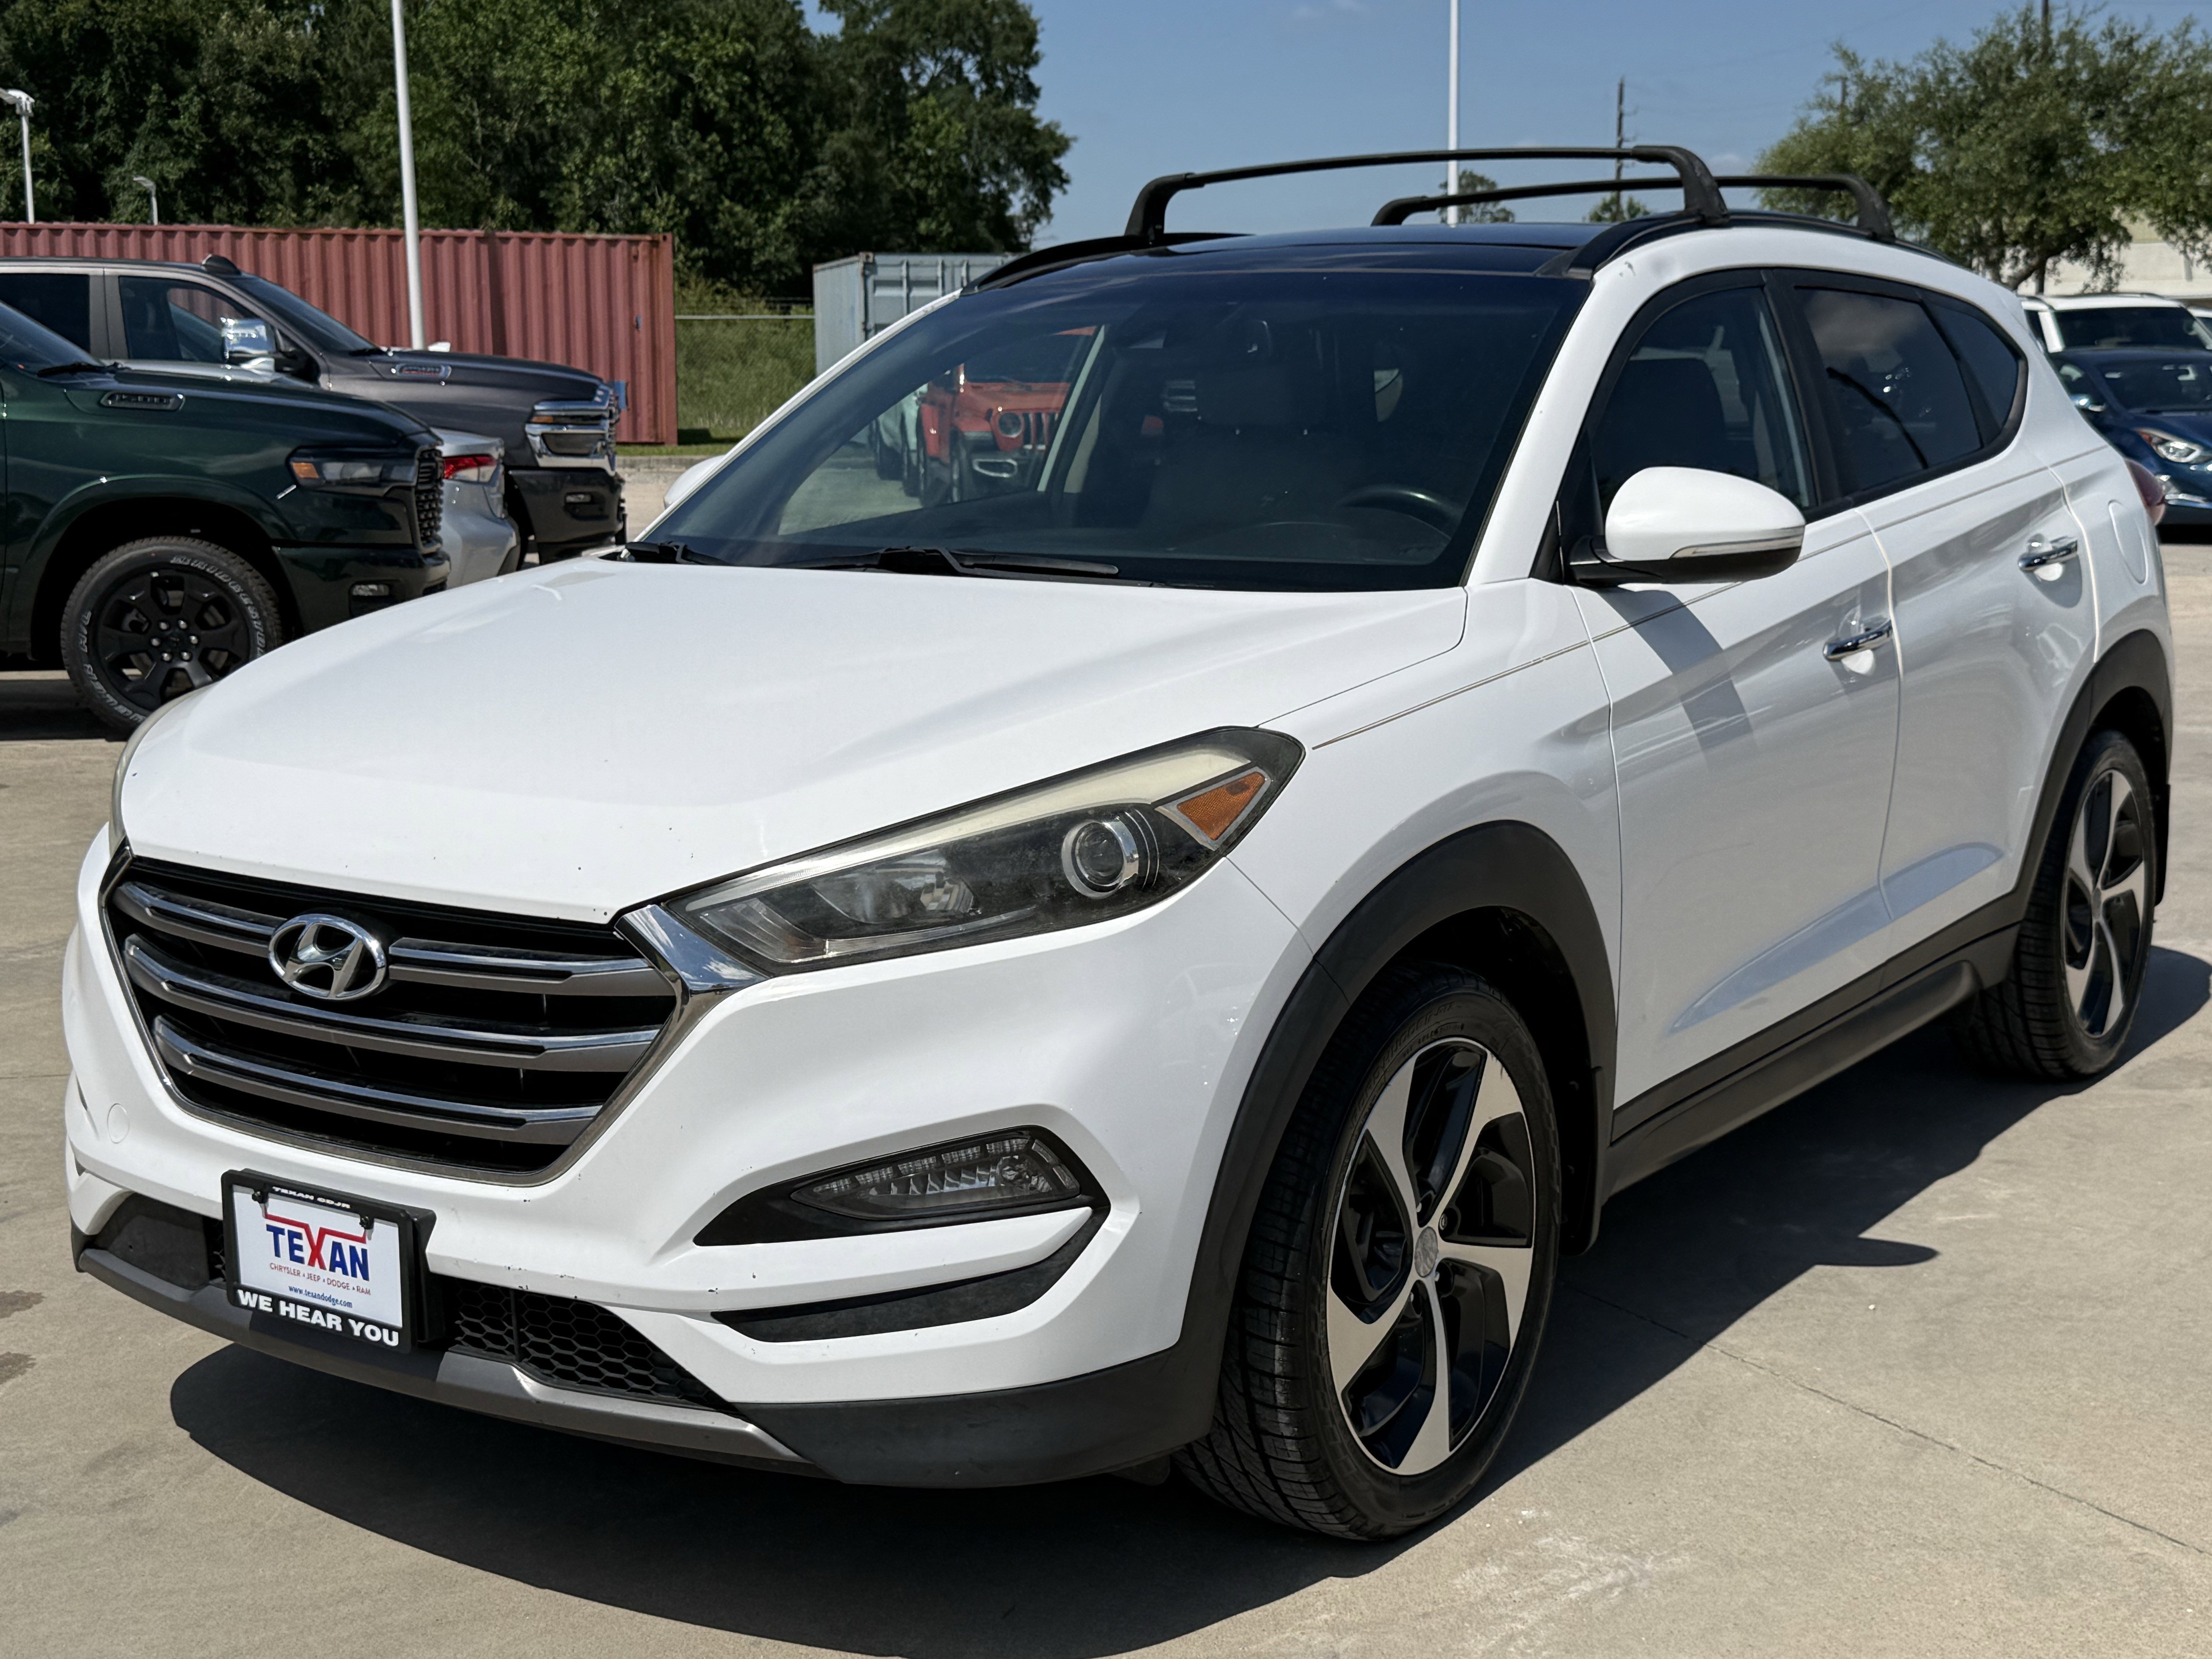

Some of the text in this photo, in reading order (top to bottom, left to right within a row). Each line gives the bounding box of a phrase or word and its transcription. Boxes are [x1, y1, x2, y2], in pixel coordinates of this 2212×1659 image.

[272, 1186, 314, 1200] TEXAN
[266, 1223, 370, 1281] TEXAN
[270, 1262, 371, 1296] CHRYSLER JEEP DODGE RAM
[288, 1285, 353, 1308] www.texandodge.com
[237, 1289, 399, 1346] WE HEAR YOU
